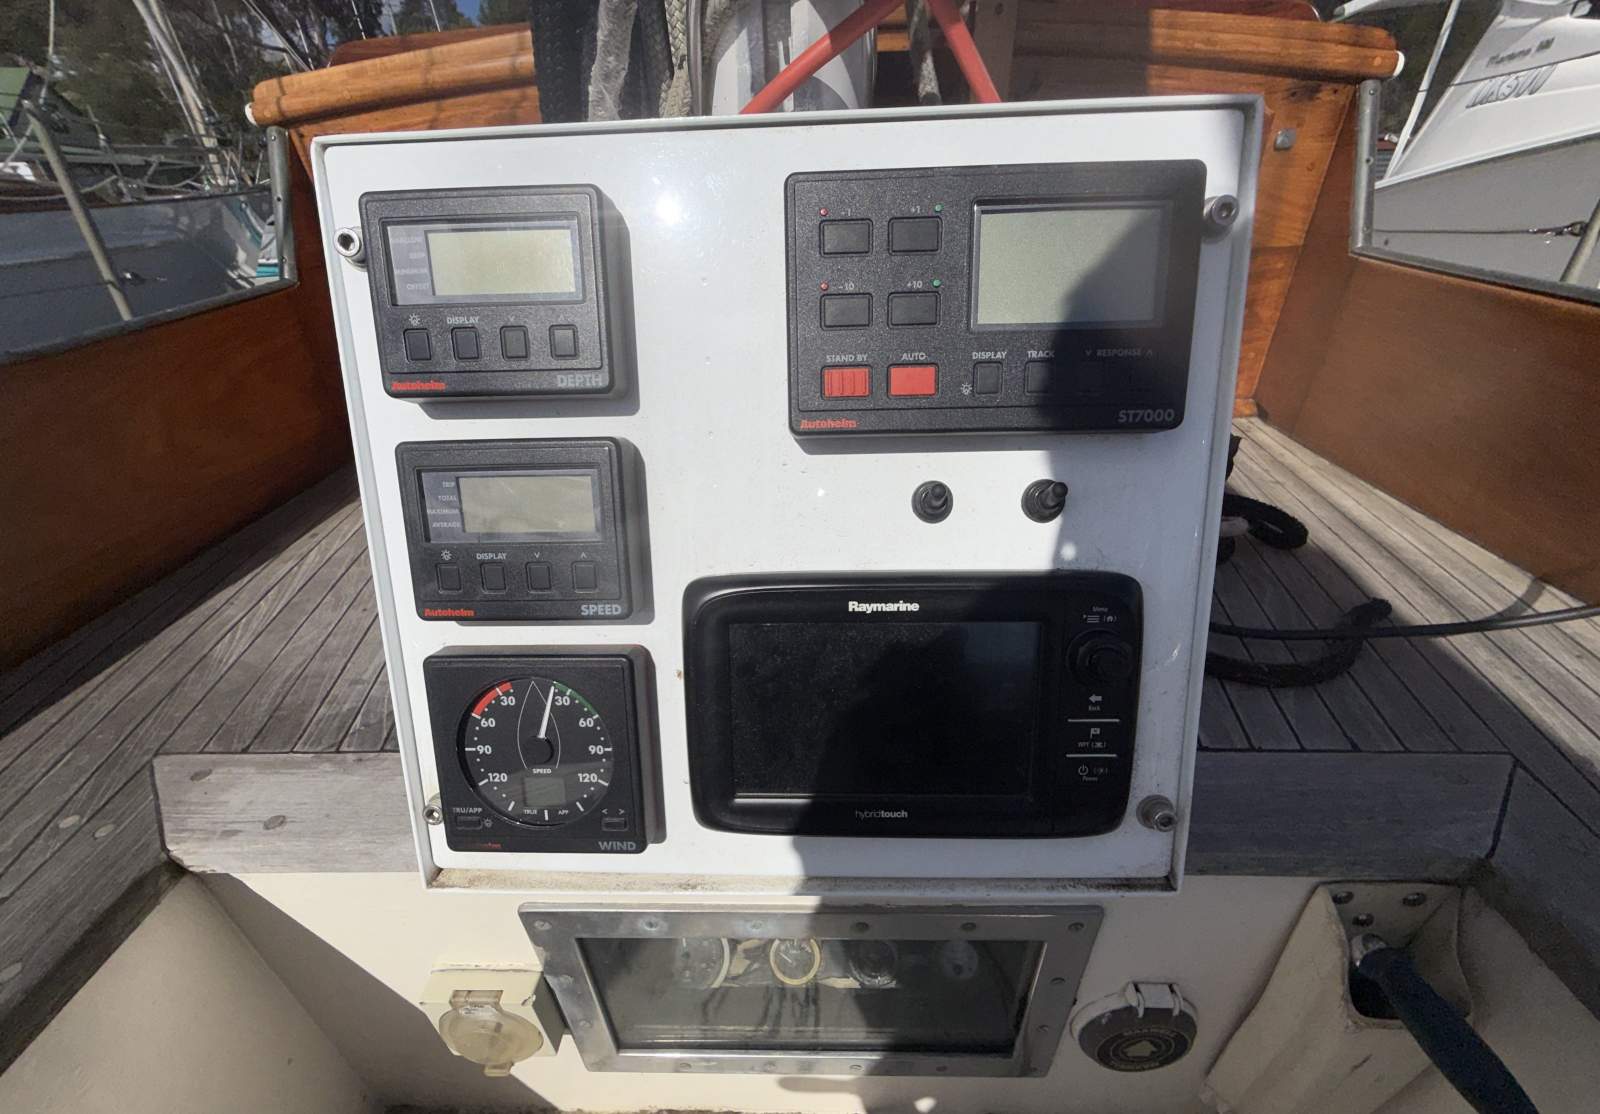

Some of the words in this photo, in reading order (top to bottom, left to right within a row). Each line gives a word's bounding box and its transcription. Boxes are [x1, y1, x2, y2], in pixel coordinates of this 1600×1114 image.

[447, 315, 480, 324] DISPLAY
[826, 354, 855, 363] STAND
[857, 353, 868, 362] BY
[902, 352, 926, 361] AUTO
[972, 350, 1007, 360] DISPLAY
[1027, 350, 1055, 358] TRACK
[556, 374, 603, 387] DEPTH
[1117, 408, 1175, 423] ST7000
[476, 552, 507, 560] DISPLAY
[580, 604, 622, 616] SPEED
[848, 600, 920, 614] Raymarine
[500, 696, 516, 706] 30
[555, 696, 570, 706] 30
[480, 718, 496, 728] 60
[579, 718, 594, 728] 60
[477, 745, 492, 755] 90
[589, 745, 604, 755] 90
[488, 773, 508, 782] 120
[578, 773, 598, 782] 120
[598, 841, 636, 851] WIND
